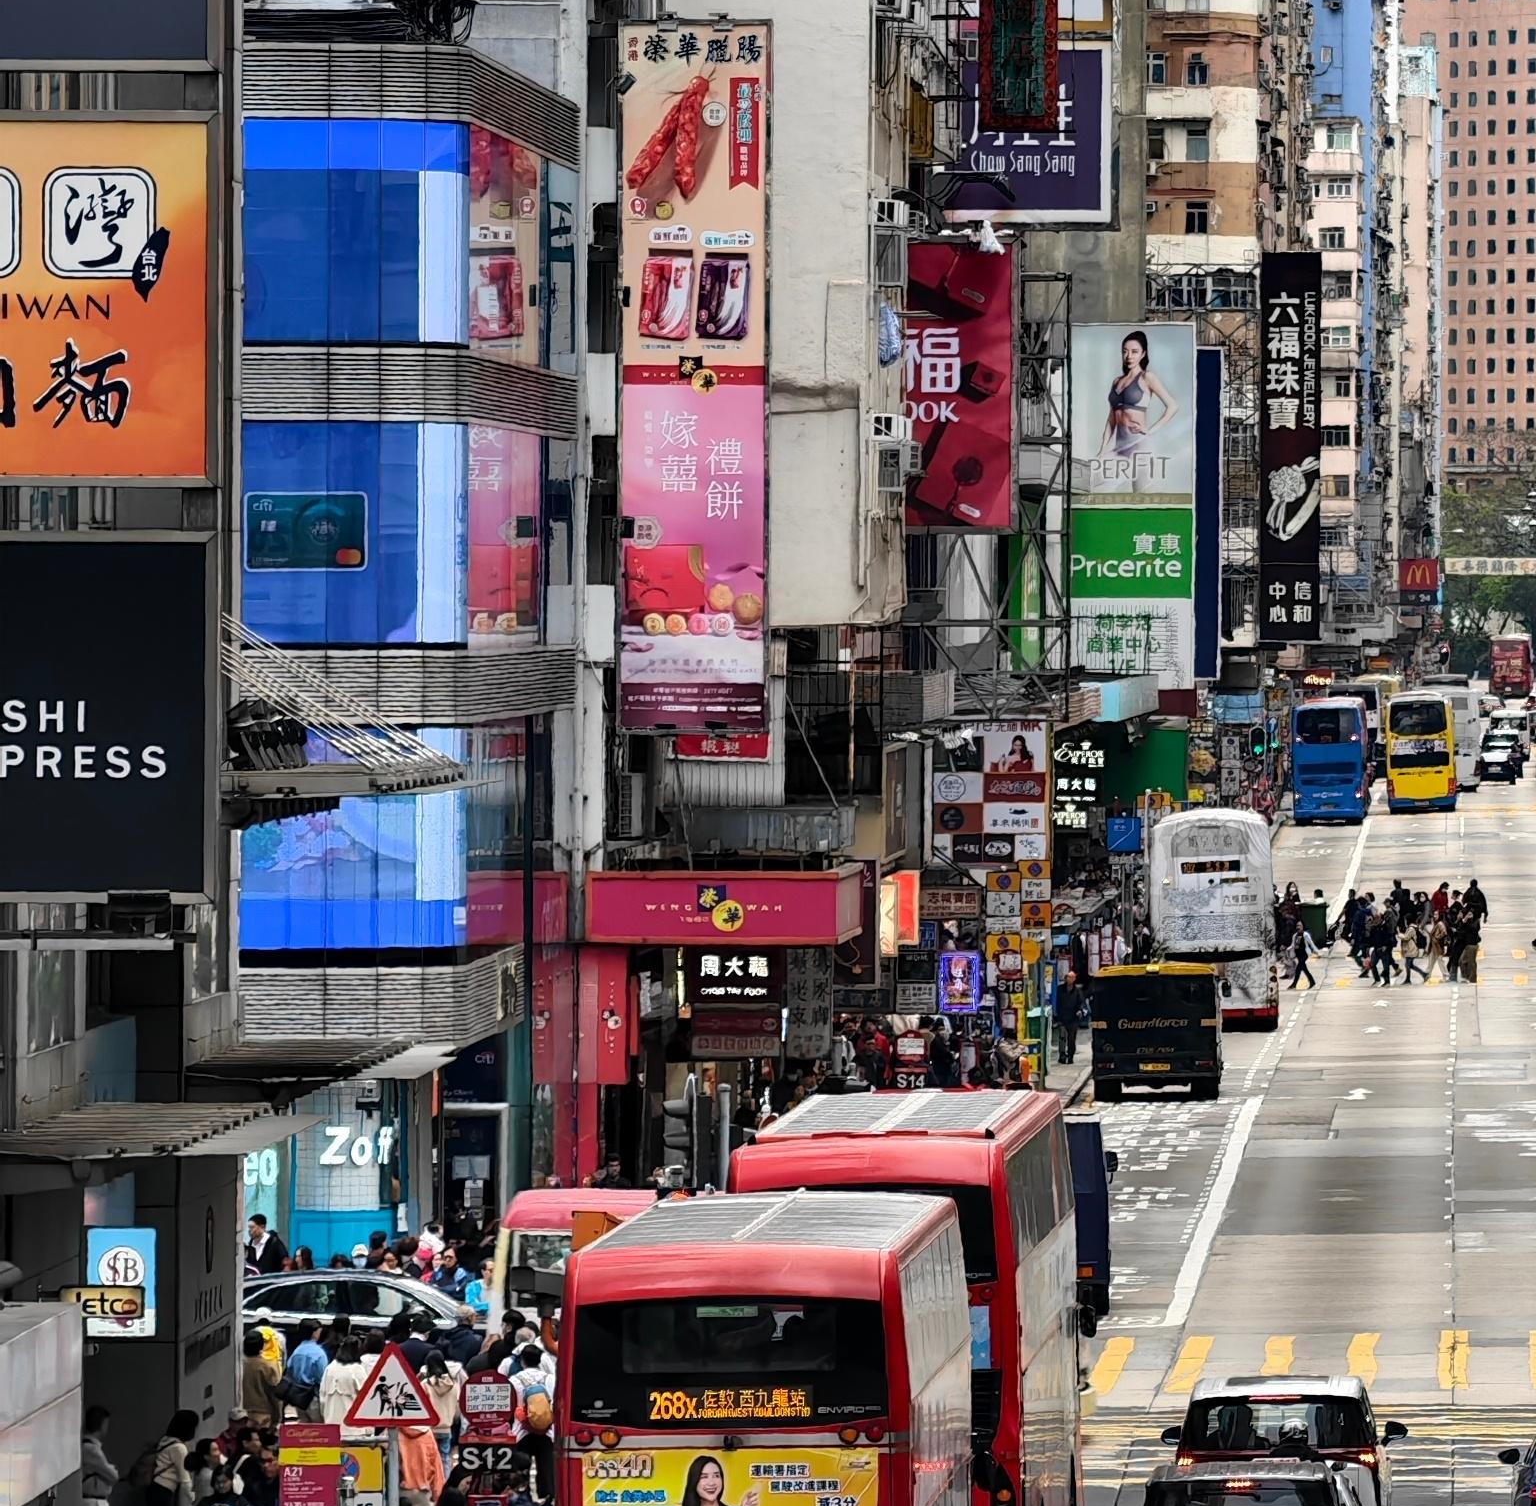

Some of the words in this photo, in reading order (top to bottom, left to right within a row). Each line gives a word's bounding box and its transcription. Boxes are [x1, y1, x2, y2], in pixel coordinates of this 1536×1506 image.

[141, 248, 158, 282] 台北
[1304, 292, 1315, 351] LUKFOOK
[1267, 292, 1300, 430] 六福珠寶
[1304, 353, 1315, 429] JEWELLERY
[705, 439, 744, 520] 禮餅
[1089, 452, 1171, 480] PERFIT
[1133, 533, 1181, 555] 實惠
[1070, 554, 1182, 578] Pricerite
[1269, 582, 1285, 623] 中心
[1294, 582, 1311, 623] 信和
[1, 701, 86, 732] SHI
[0, 745, 168, 778] PRESS
[700, 956, 768, 977] 周大福
[1118, 1018, 1188, 1030] Guardforce
[897, 1074, 925, 1089] S14
[284, 1467, 302, 1477] A21
[461, 1447, 512, 1470] S12
